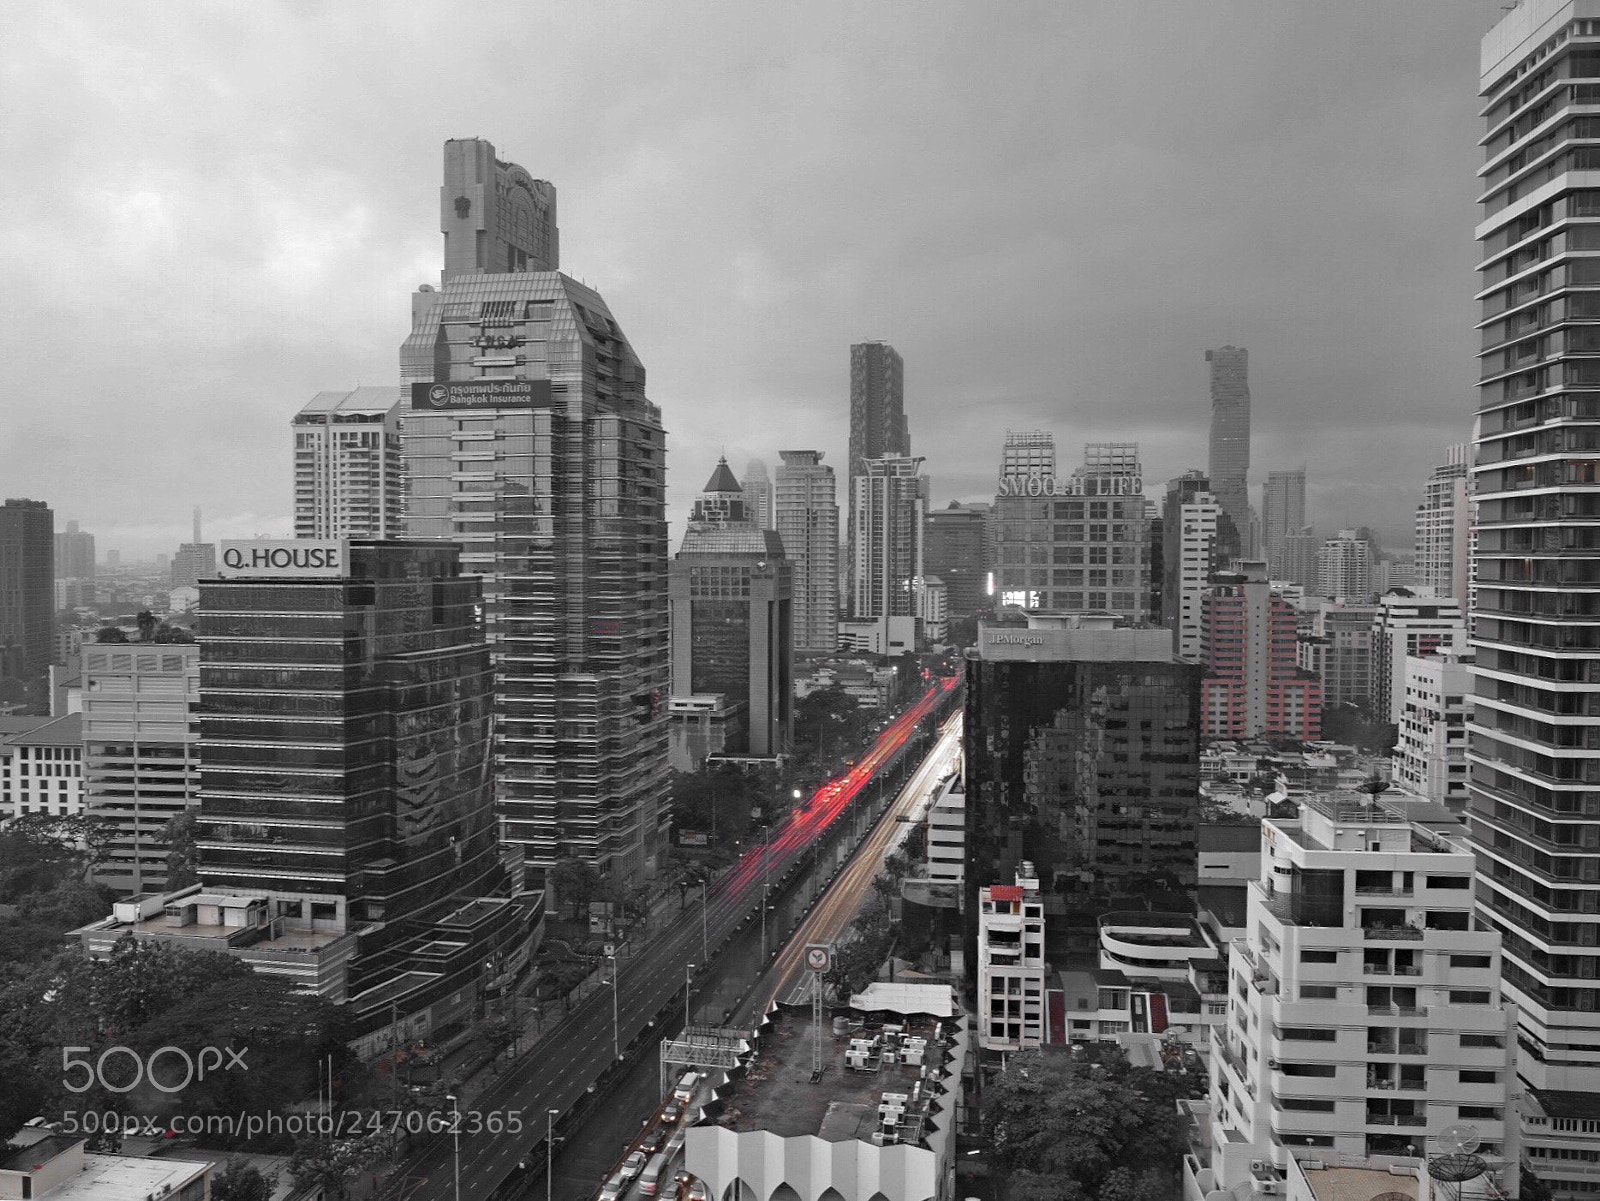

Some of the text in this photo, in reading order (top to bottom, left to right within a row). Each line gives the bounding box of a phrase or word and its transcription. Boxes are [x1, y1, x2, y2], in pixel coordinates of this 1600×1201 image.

[450, 394, 488, 405] Bangkok
[999, 477, 1142, 496] SMOOH LIFE
[223, 548, 339, 569] Q.HOUSE
